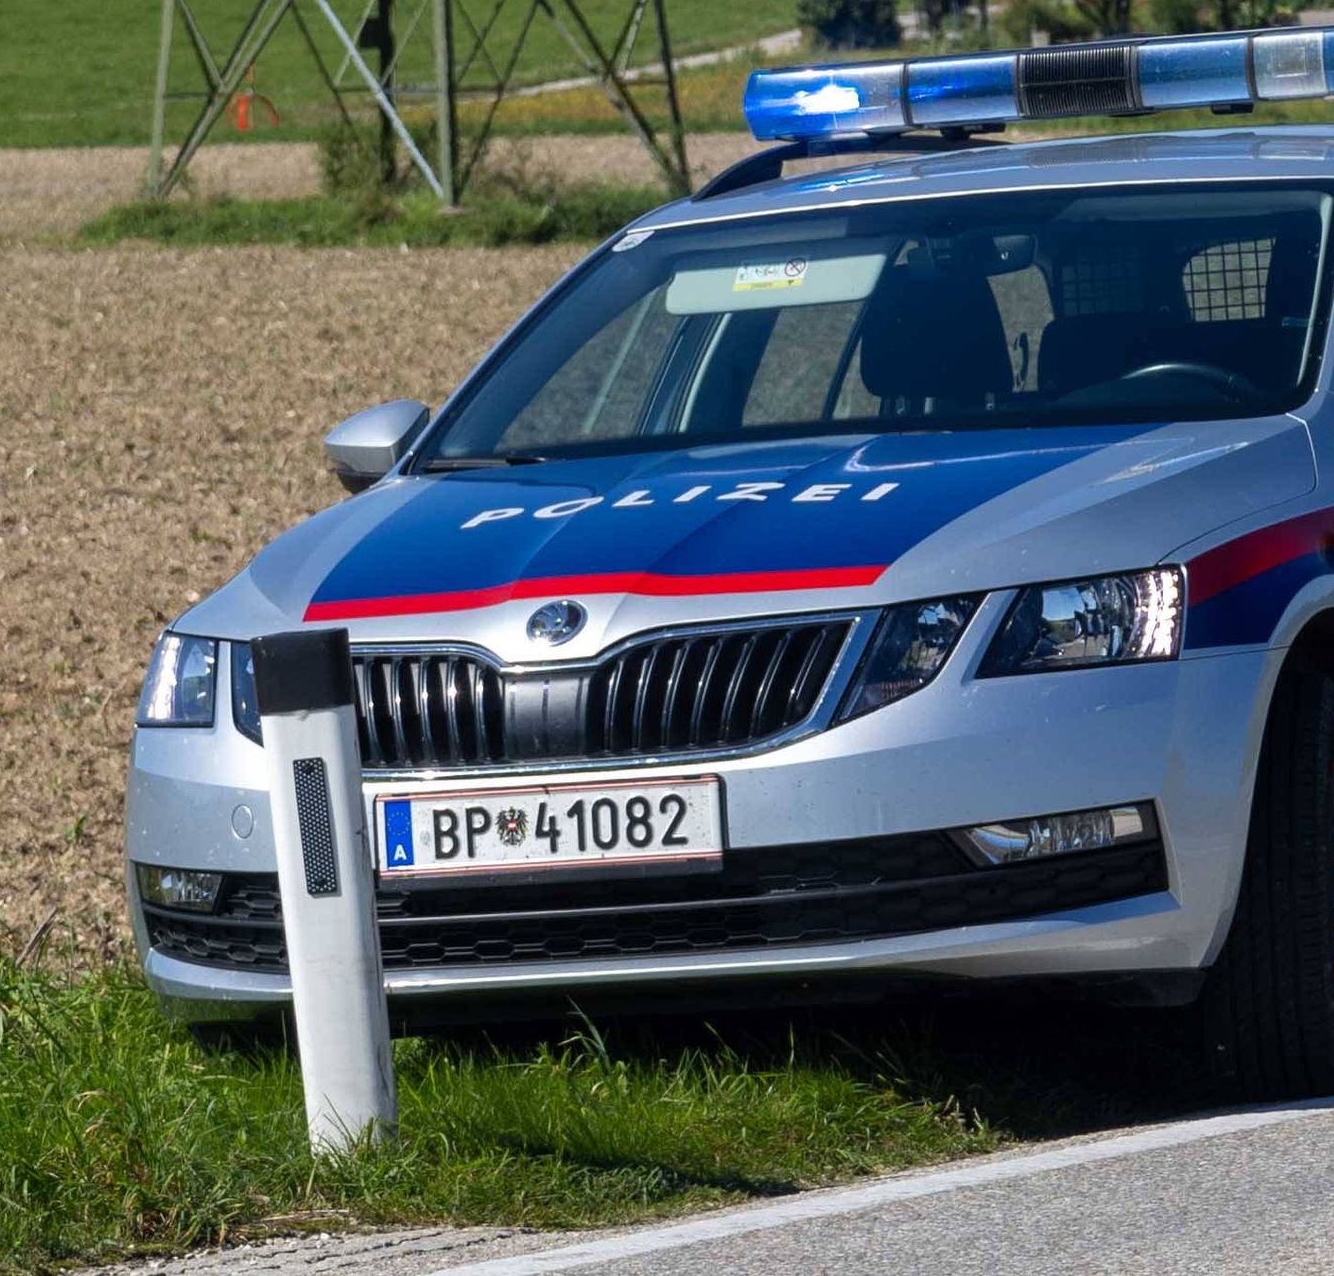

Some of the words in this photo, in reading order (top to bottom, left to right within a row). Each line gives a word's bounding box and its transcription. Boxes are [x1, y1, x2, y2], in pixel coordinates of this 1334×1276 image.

[461, 482, 899, 529] POLIZEI
[433, 806, 492, 860] BP
[534, 793, 688, 854] 41082
[394, 843, 408, 861] A
